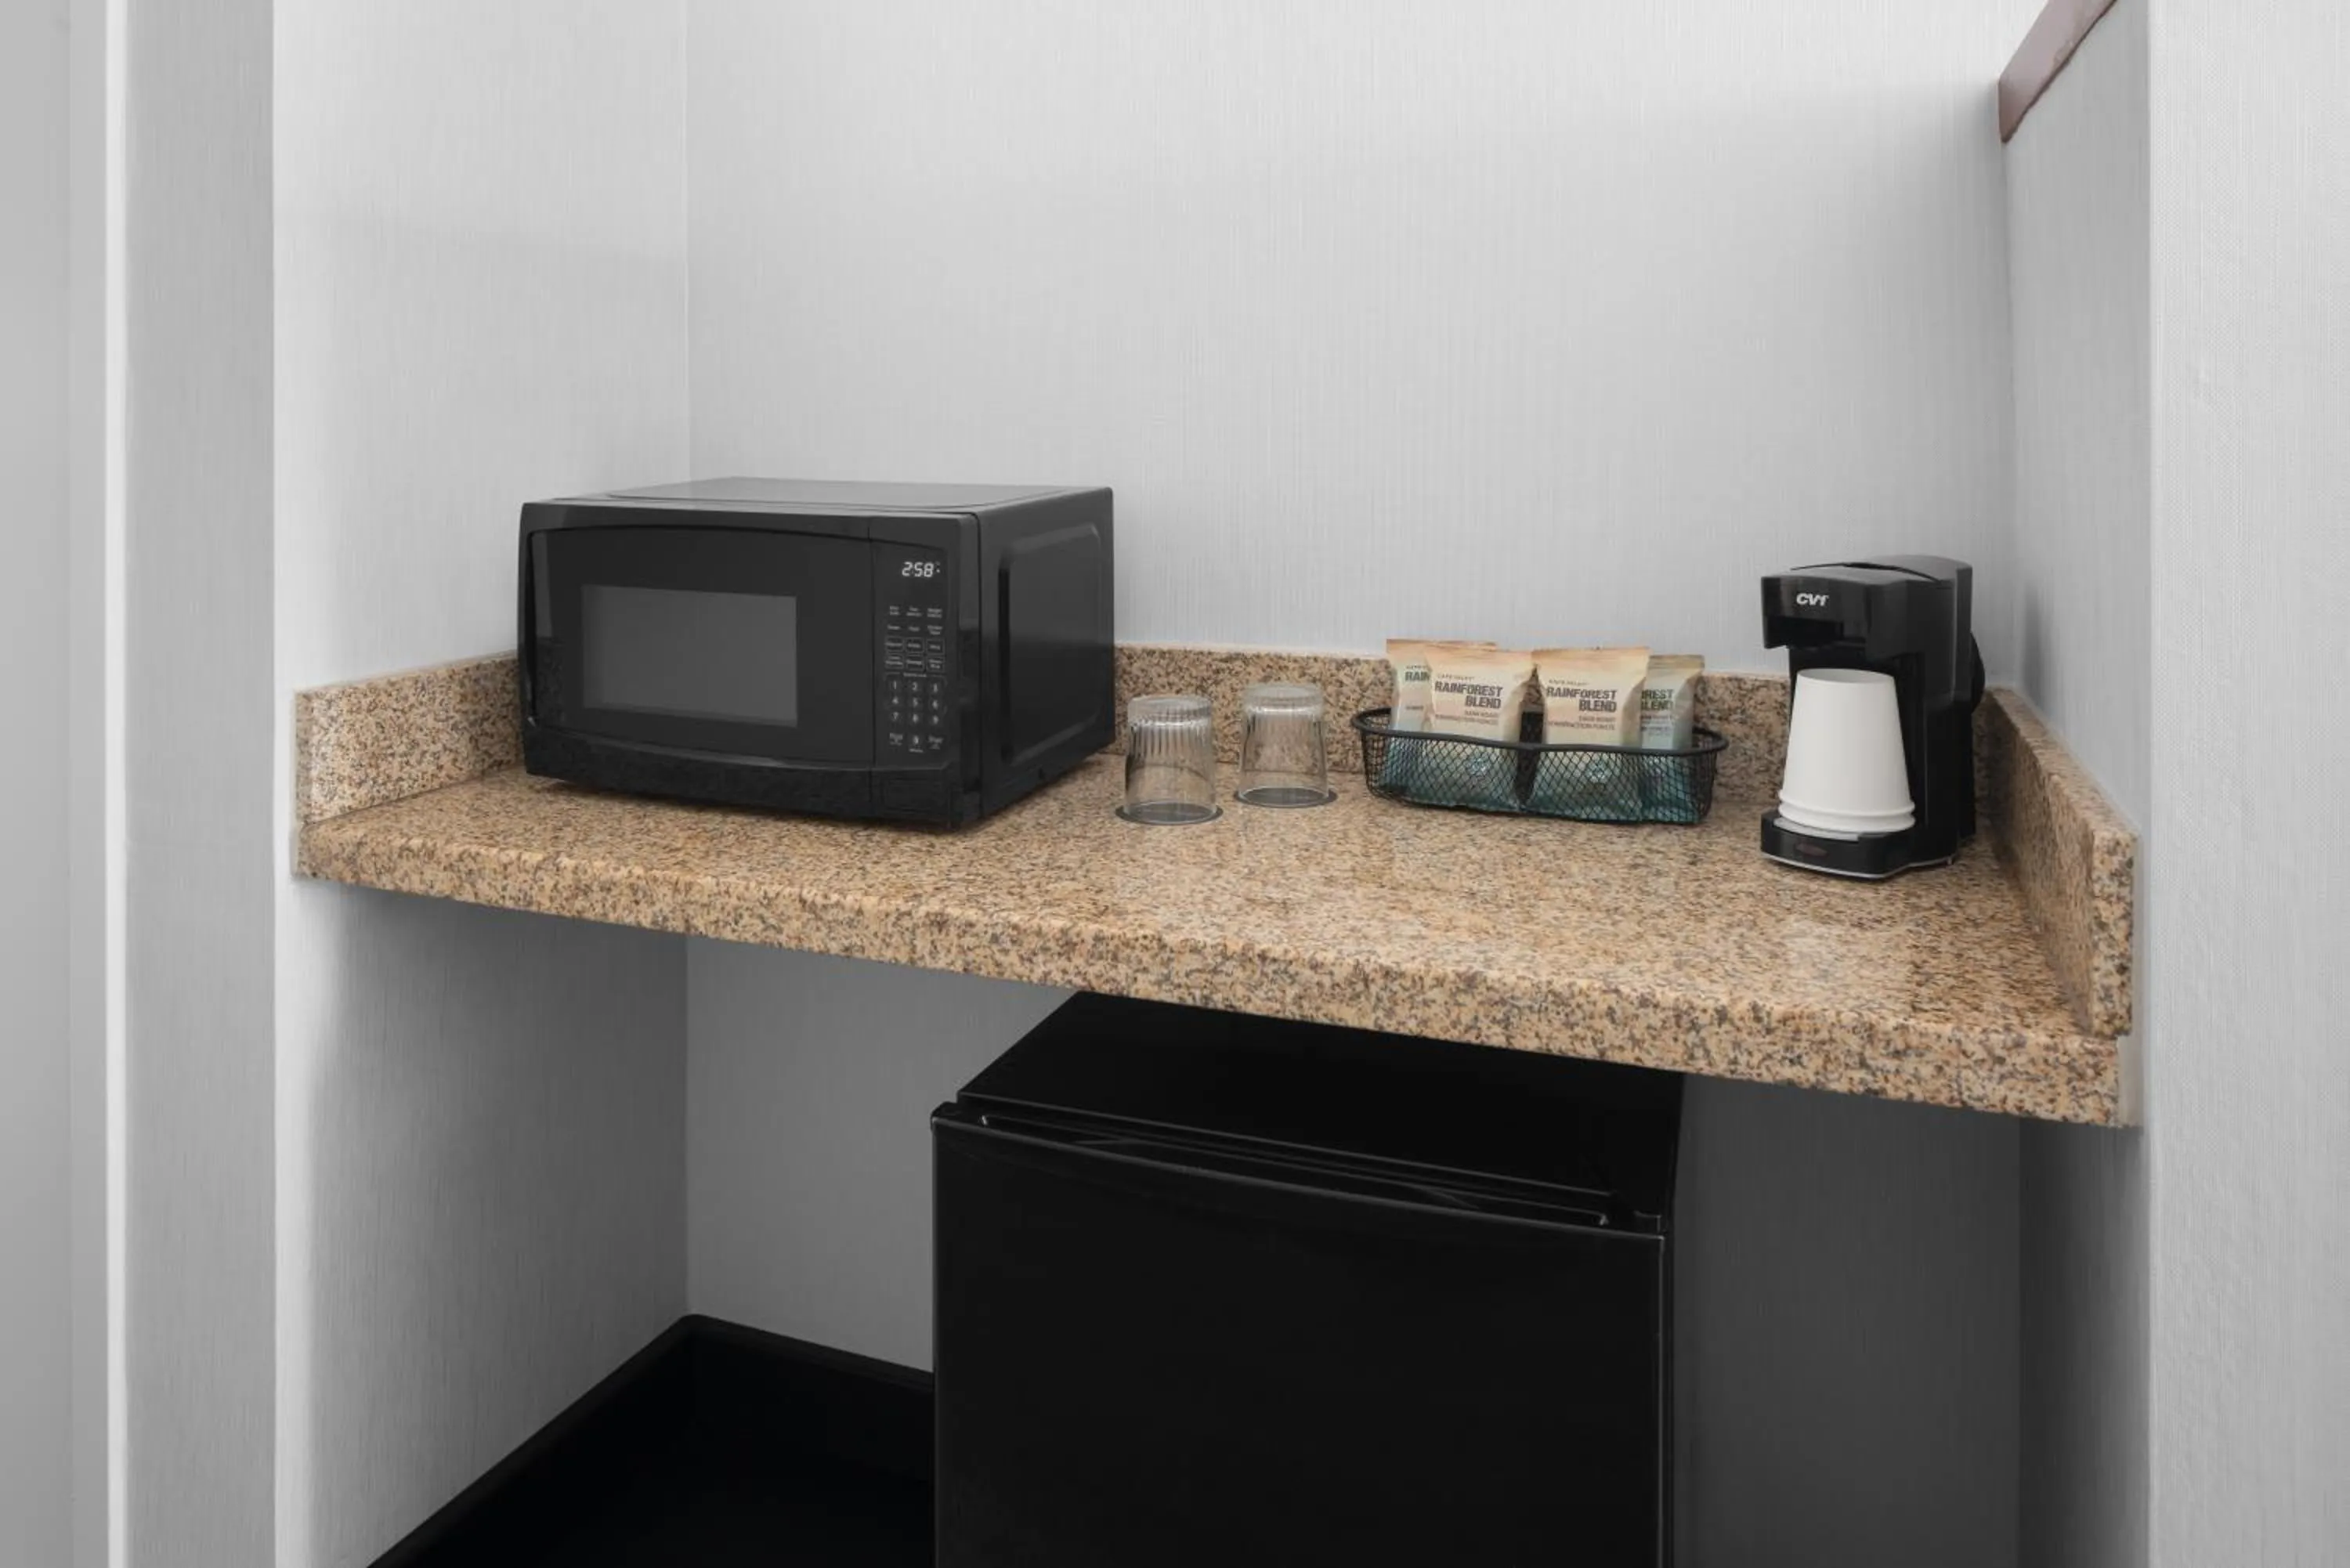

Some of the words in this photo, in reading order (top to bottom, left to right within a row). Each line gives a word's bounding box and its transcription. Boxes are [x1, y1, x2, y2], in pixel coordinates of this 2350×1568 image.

[1434, 680, 1503, 697] RAINFOREST
[1546, 686, 1618, 699] RAINFOREST
[1464, 695, 1502, 709] BLEND
[1578, 699, 1618, 713] BLEND
